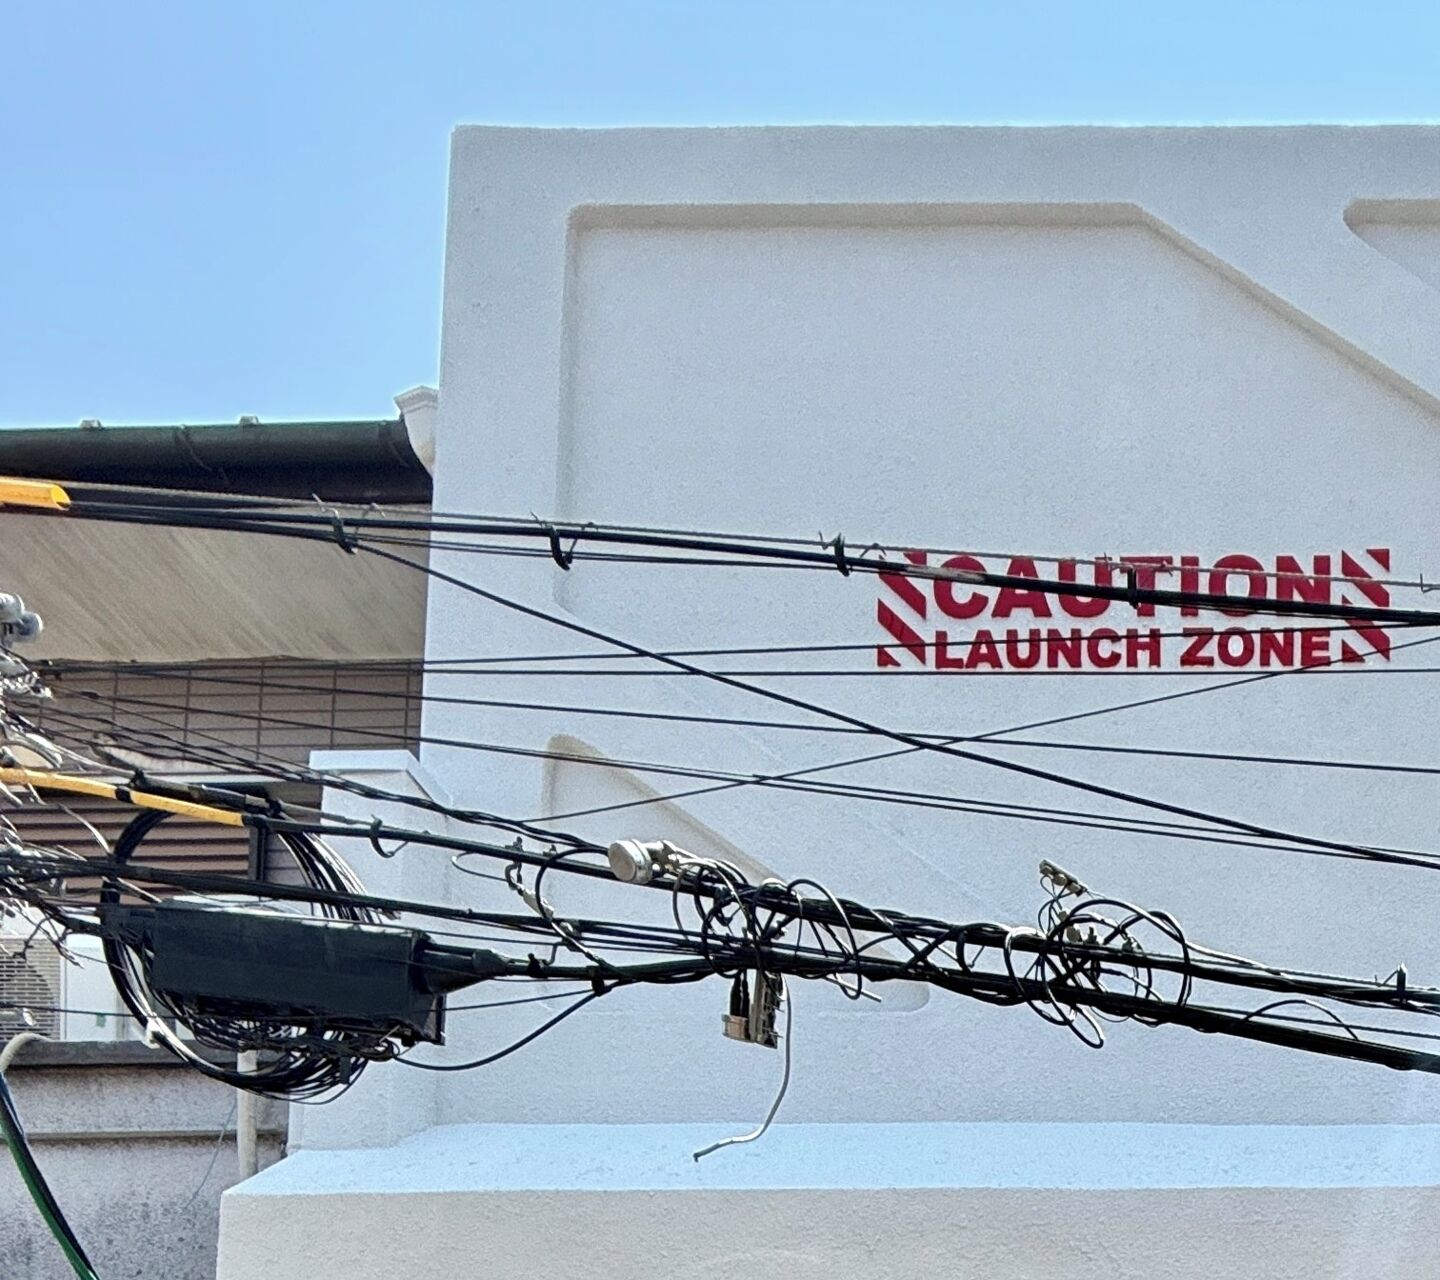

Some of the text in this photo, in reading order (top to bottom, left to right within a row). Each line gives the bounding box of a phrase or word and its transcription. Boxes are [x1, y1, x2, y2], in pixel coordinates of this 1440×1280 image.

[933, 553, 1332, 620] CAUTION
[934, 627, 1332, 670] LAUNCH ZONE
